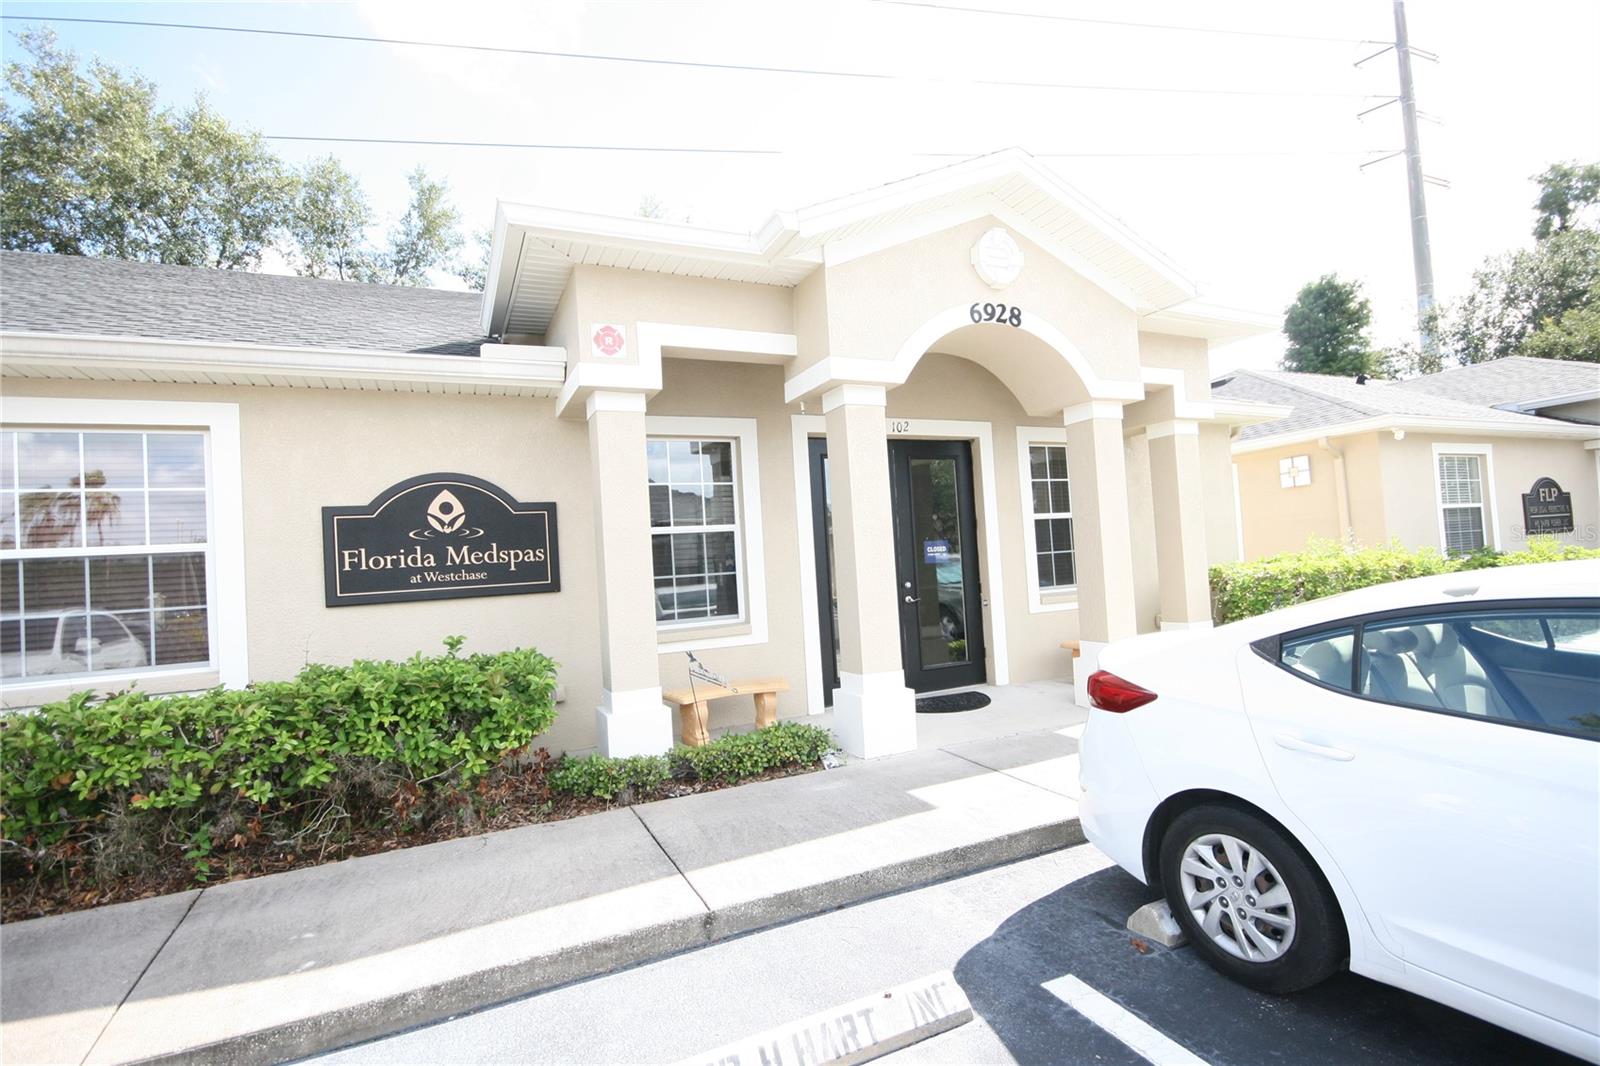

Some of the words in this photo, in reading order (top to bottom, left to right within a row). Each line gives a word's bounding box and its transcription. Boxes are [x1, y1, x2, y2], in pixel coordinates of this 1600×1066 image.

[969, 302, 1022, 328] 6928
[890, 421, 910, 433] 102
[1538, 487, 1559, 502] FLP
[926, 545, 947, 553] CLOSED
[341, 545, 437, 572] Florida
[445, 542, 546, 572] Medspas
[409, 572, 422, 584] at
[423, 570, 488, 583] Westchase
[791, 1006, 878, 1066] HART
